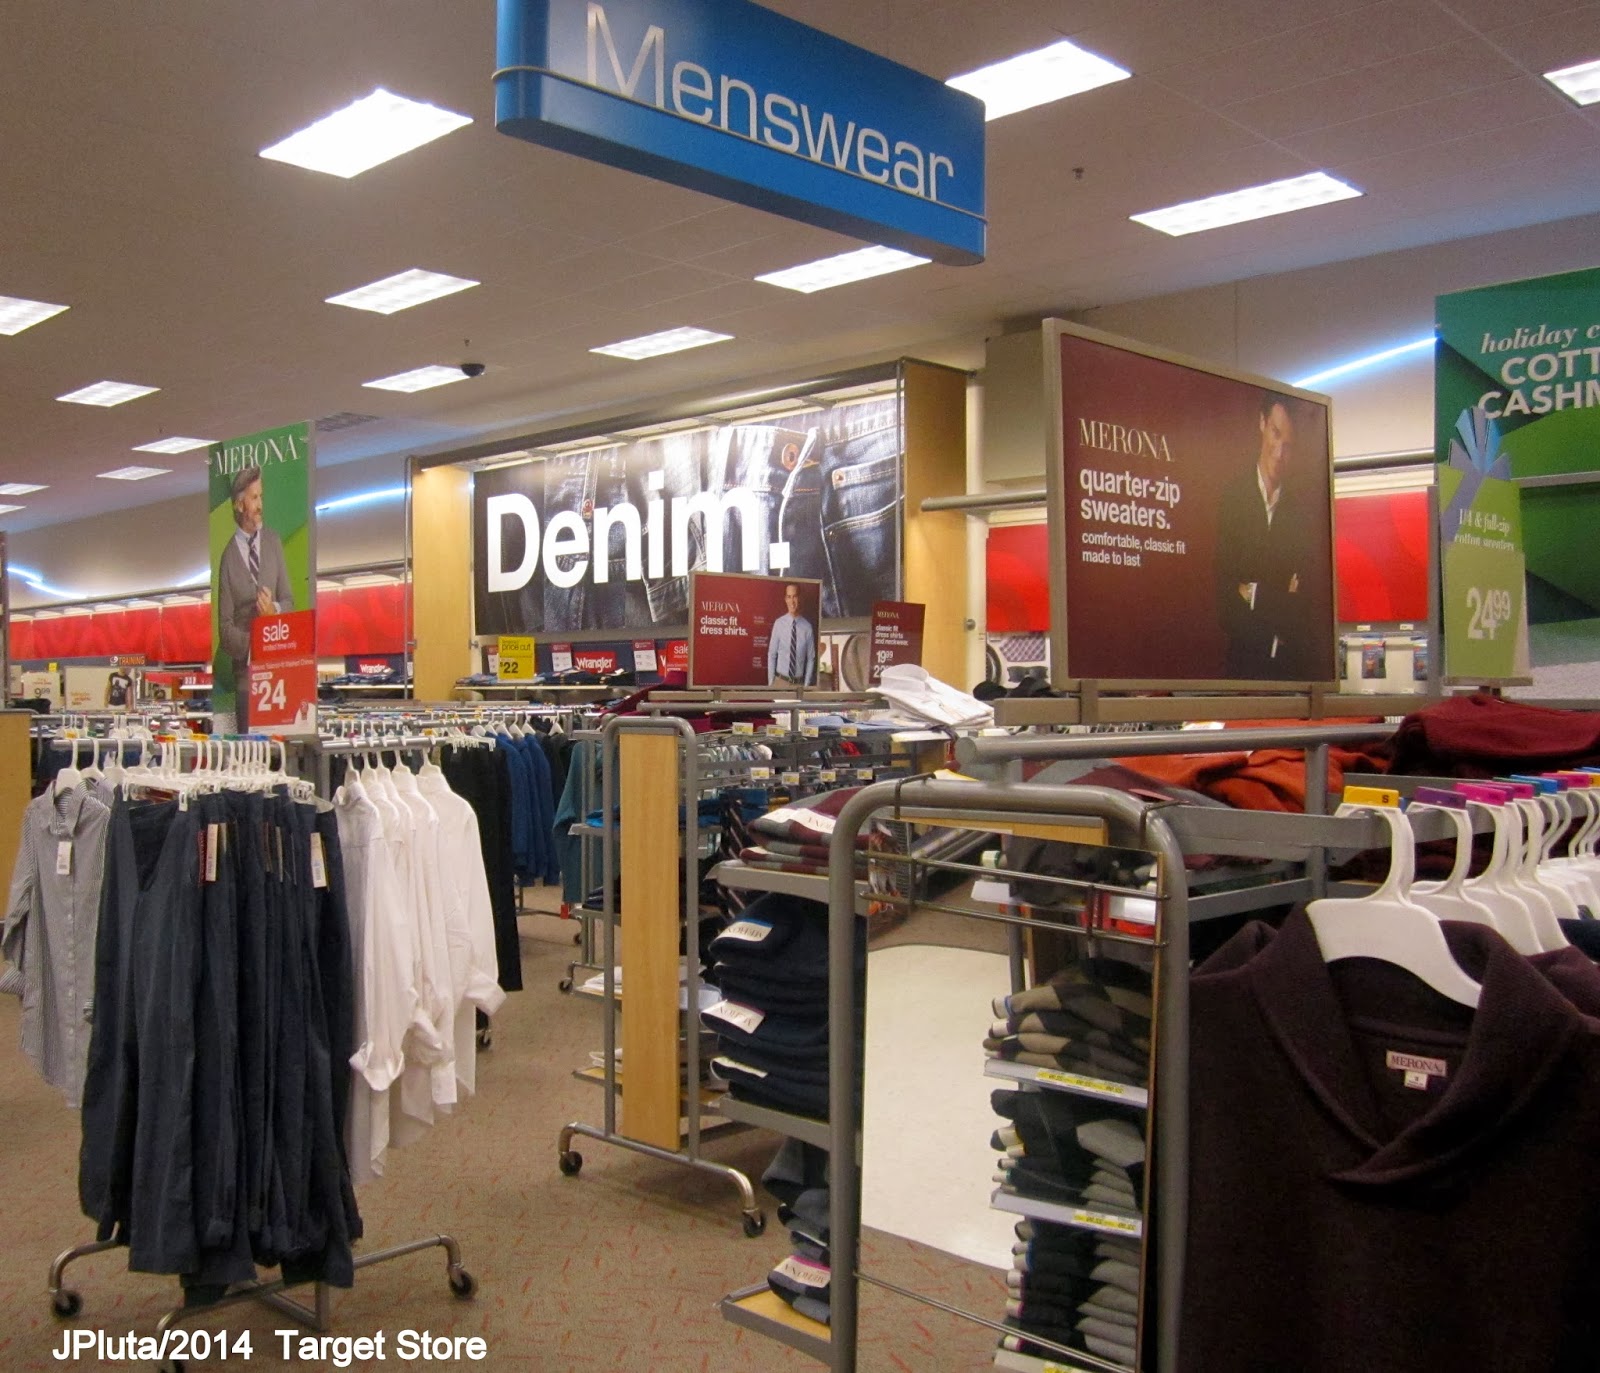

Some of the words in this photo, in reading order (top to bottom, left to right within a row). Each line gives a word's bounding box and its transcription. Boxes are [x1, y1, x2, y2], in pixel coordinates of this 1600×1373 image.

[584, 1, 954, 202] Menswear
[1481, 324, 1578, 354] holiday
[1079, 418, 1175, 462] MERONA
[216, 434, 301, 477] MERONA
[1079, 468, 1181, 508] quarter-zip
[1080, 498, 1171, 529] sweaters.
[1474, 511, 1482, 528] &
[1483, 513, 1511, 537] full-zip
[487, 470, 790, 593] Denim.
[1082, 532, 1142, 552] comfortable,
[1144, 537, 1174, 553] classic
[1176, 541, 1186, 554] fit
[1082, 550, 1110, 564] made
[1112, 552, 1122, 565] to
[1124, 552, 1141, 567] last
[702, 600, 741, 613] MERONA
[263, 619, 289, 642] sale
[700, 615, 728, 626] classic
[729, 616, 738, 626] fit
[700, 625, 722, 635] dress
[724, 626, 748, 636] shirts.
[501, 642, 519, 652] price
[520, 643, 531, 651] cut
[119, 655, 145, 665] TRAINING
[575, 656, 613, 674] Wrangler
[251, 679, 287, 711] $24
[1382, 794, 1389, 803] S
[1391, 1055, 1443, 1073] MERONA
